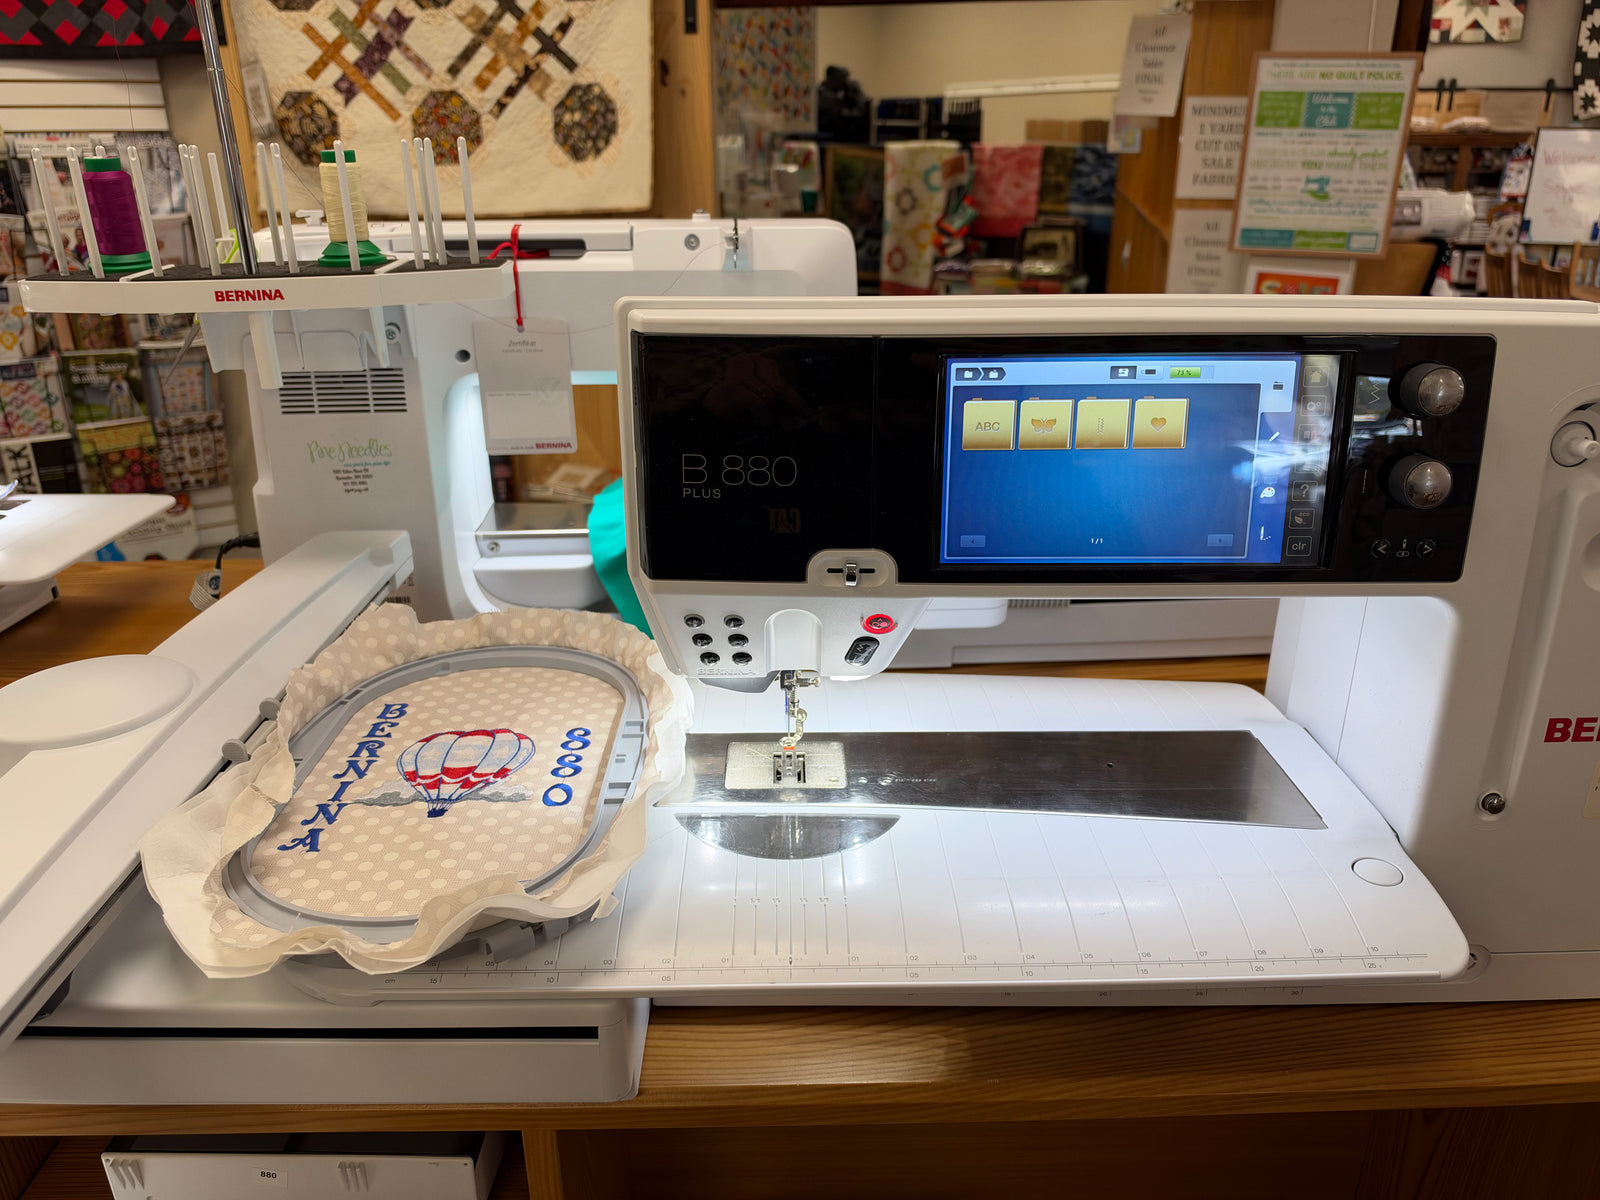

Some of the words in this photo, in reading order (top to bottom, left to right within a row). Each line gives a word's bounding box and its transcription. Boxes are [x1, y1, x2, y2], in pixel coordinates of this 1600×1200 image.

[1318, 71, 1335, 80] NO
[1336, 71, 1364, 80] QUILT
[1191, 104, 1247, 117] MINIMU
[1194, 140, 1222, 153] CUT
[1201, 157, 1234, 170] SALE
[214, 288, 285, 303] BERNINA
[975, 421, 1001, 432] ABC
[535, 441, 573, 449] BERNINA
[682, 453, 708, 485] B
[721, 454, 798, 487] 880
[682, 487, 722, 499] PLUS
[1291, 541, 1307, 551] clr
[1543, 717, 1600, 743] BE
[277, 702, 409, 853] BERNINA
[543, 959, 554, 967] 04
[851, 954, 860, 962] 01
[1198, 950, 1208, 958] 07
[546, 976, 555, 984] 10
[661, 975, 672, 983] 05
[909, 971, 920, 979] 05
[1025, 970, 1034, 978] 10
[1140, 968, 1149, 976] 15
[1254, 965, 1265, 973] 20
[259, 1170, 278, 1180] 880
